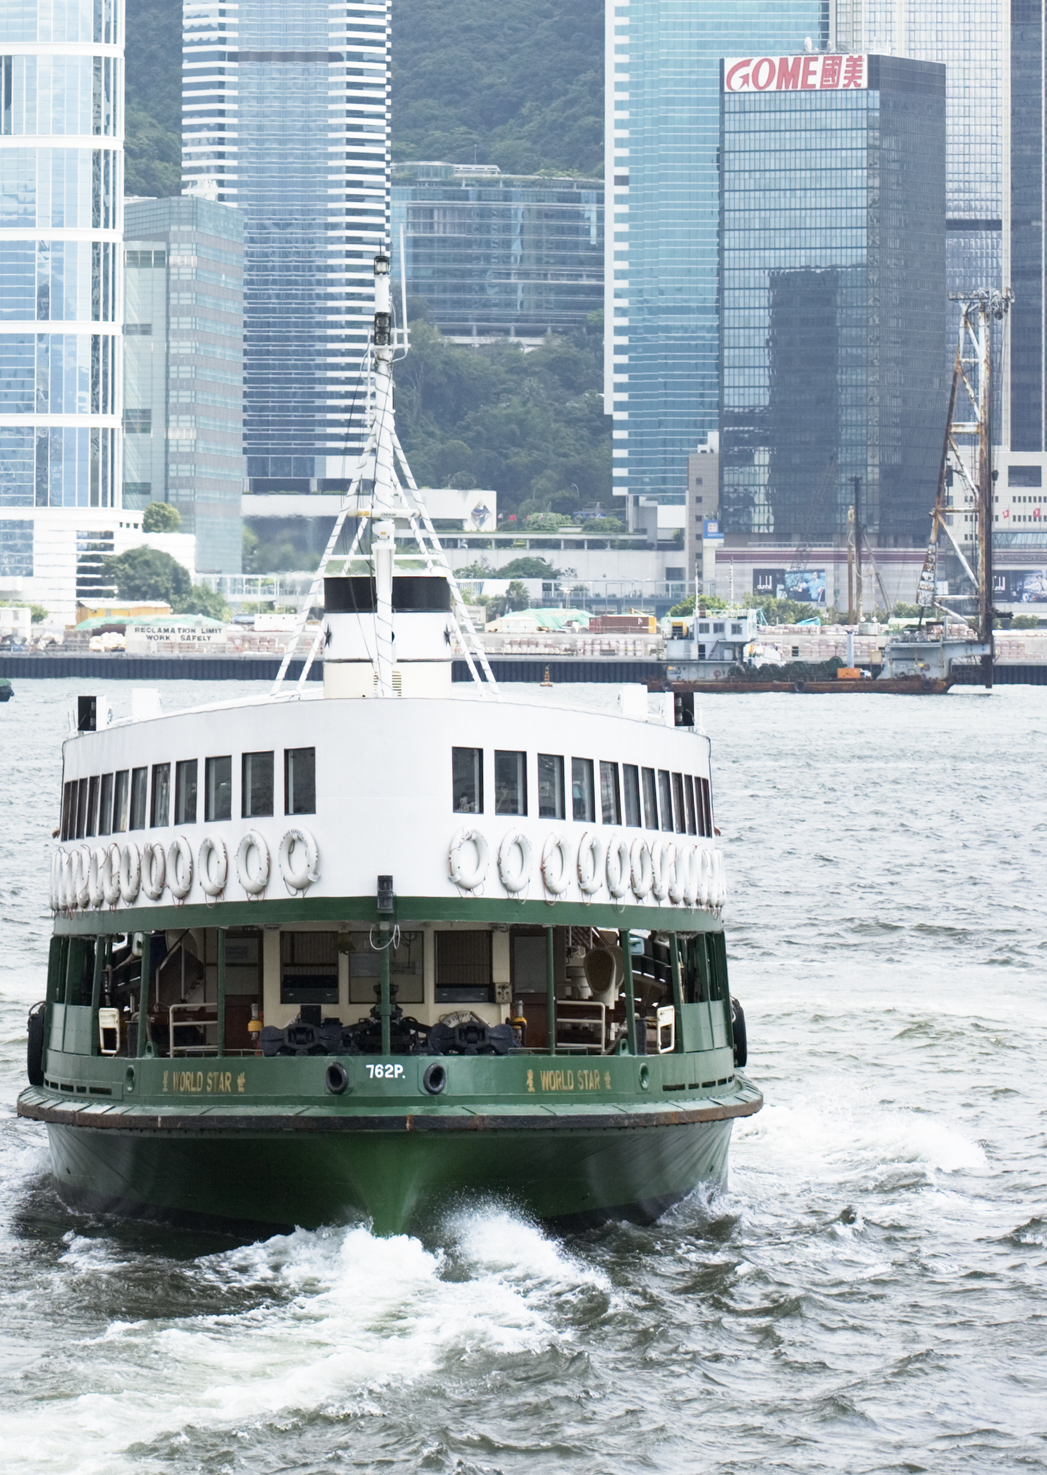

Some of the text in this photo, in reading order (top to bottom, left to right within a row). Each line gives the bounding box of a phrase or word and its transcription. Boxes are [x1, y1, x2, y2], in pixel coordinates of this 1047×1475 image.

[726, 55, 863, 91] GOME 國美
[172, 1071, 203, 1092] WORLD
[206, 1071, 232, 1092] STAR
[539, 1070, 574, 1091] WORLD
[577, 1069, 601, 1091] STAR
